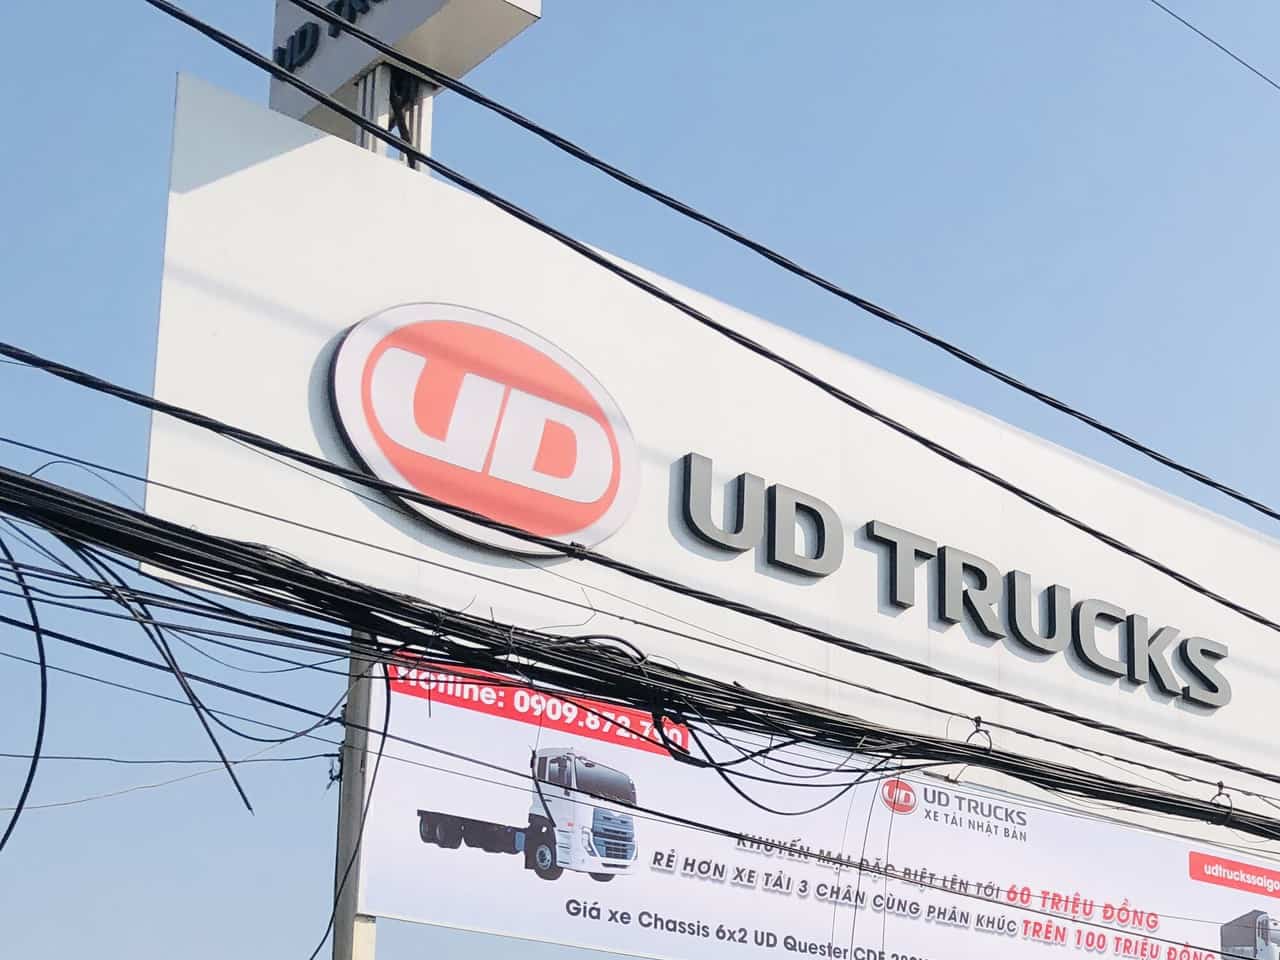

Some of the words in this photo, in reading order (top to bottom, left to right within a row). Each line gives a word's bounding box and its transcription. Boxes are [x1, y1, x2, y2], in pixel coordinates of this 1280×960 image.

[370, 345, 614, 504] UD
[678, 451, 845, 578] UD
[866, 519, 1232, 709] TRUCKS
[924, 787, 950, 807] UD
[954, 795, 1028, 826] TRUCKS
[924, 809, 940, 823] XE
[943, 810, 963, 828] TẢI
[968, 818, 999, 838] NHẬT
[1003, 825, 1027, 843] BẢN
[565, 898, 602, 921] Giá
[607, 908, 632, 925] xe
[638, 910, 711, 939] Chassis
[715, 924, 749, 945] 6x2
[753, 929, 778, 949] UD
[783, 935, 849, 960] Quester
[652, 848, 676, 869] RẺ
[682, 856, 726, 879] HƠN
[733, 867, 756, 884] XE
[763, 870, 792, 891] TẢI
[798, 879, 809, 894] 3
[815, 882, 866, 905] CHÂN
[872, 885, 921, 916] CÙNG
[926, 904, 970, 926] PHÂN
[975, 909, 1017, 933] KHÚC
[1022, 919, 1067, 943] TRÊN
[1075, 928, 1107, 951] 100
[942, 873, 969, 894] LÊN
[975, 880, 1001, 898] TỚI
[1006, 884, 1032, 906] 60
[1040, 889, 1094, 922] TRIỆU
[1102, 897, 1160, 931] ĐỒNG
